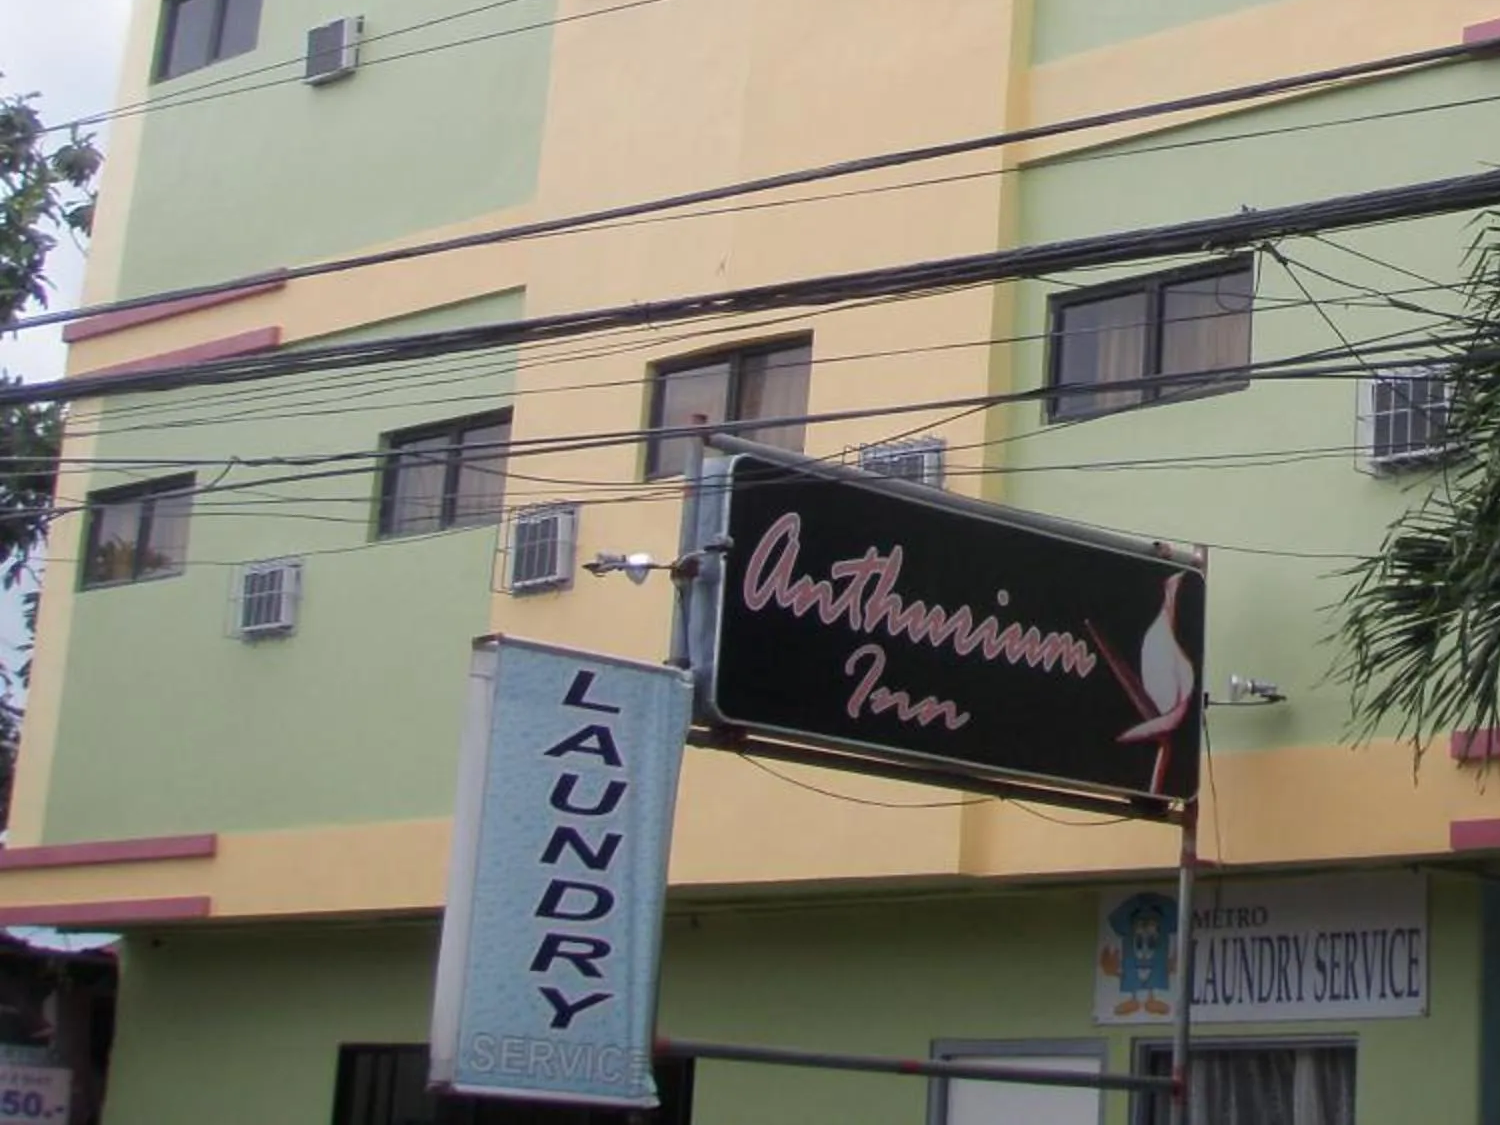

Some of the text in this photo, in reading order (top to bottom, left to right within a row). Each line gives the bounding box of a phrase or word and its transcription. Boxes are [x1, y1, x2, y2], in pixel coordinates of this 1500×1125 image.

[743, 512, 1096, 678] Anthurium
[845, 644, 970, 730] Inn
[529, 670, 628, 1029] LAUNDRY
[1192, 905, 1269, 929] METRO
[1188, 927, 1421, 1006] LAUNDRY SERVICE
[469, 1031, 651, 1089] SERVICE
